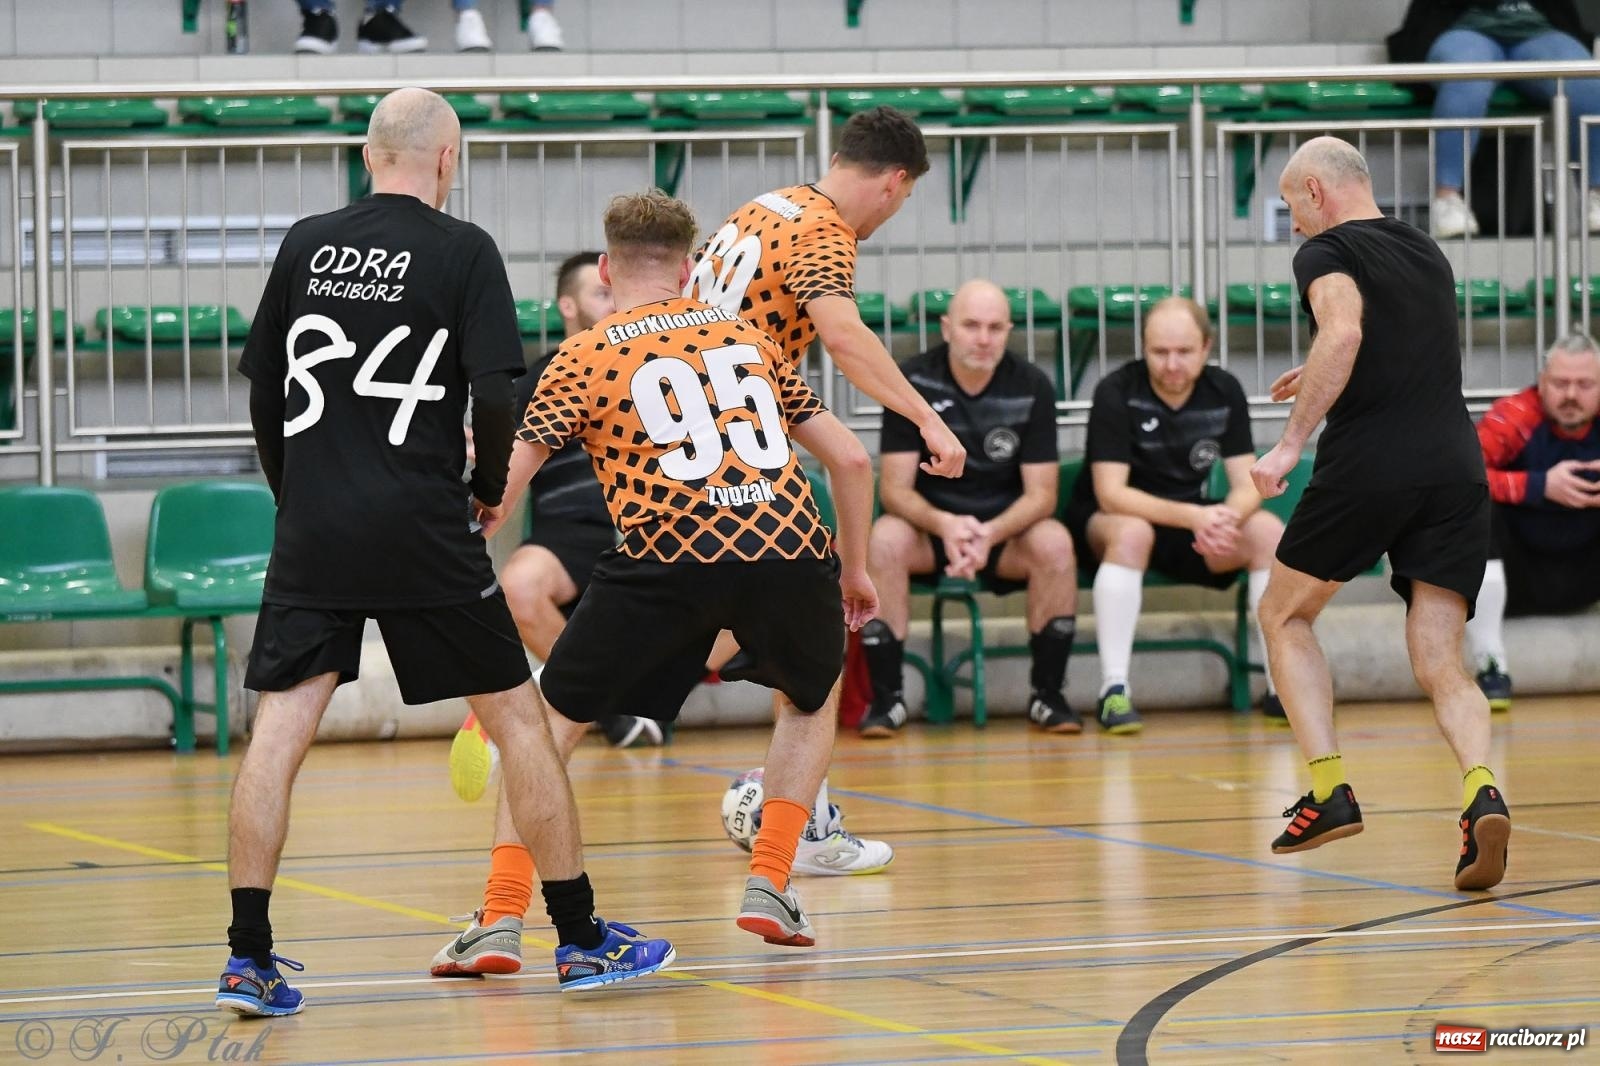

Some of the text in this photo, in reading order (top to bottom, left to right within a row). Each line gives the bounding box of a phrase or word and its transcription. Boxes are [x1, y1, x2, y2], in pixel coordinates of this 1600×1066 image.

[310, 245, 411, 279] ODRA
[307, 279, 404, 302] RACIBÓRZ
[284, 313, 449, 446] 84
[630, 343, 790, 481] 95
[733, 787, 757, 834] SELECT
